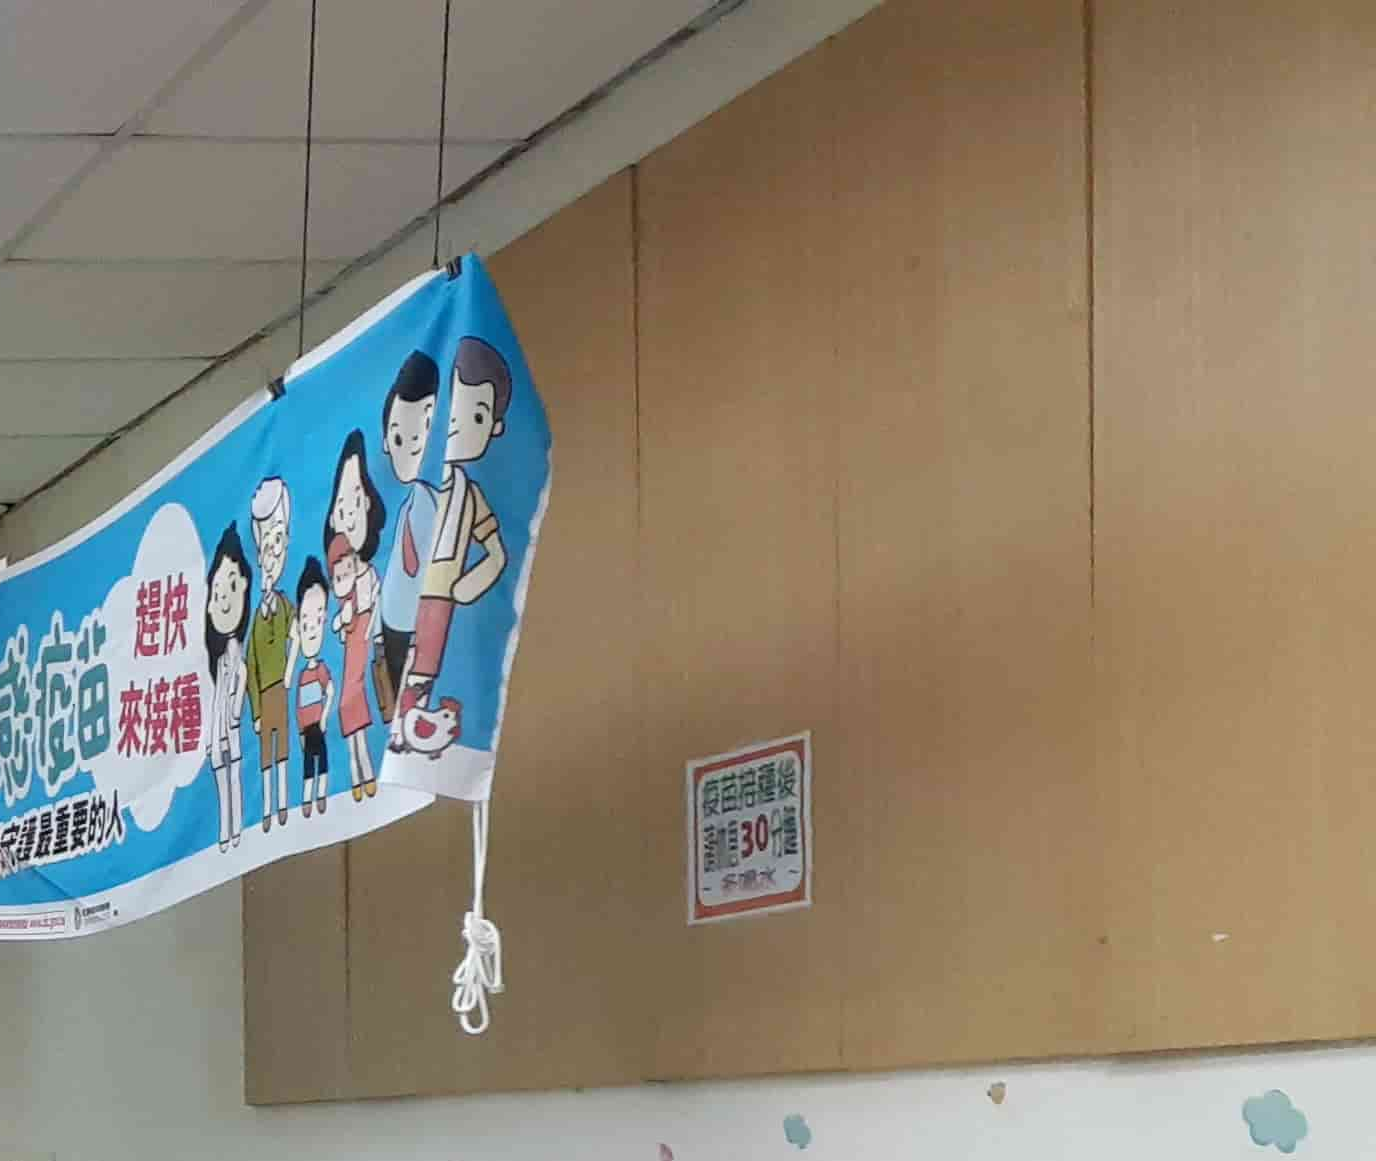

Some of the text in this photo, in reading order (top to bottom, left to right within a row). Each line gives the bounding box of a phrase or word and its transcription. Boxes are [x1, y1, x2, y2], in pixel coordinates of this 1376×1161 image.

[134, 572, 189, 658] 趕快
[117, 672, 202, 757] 來接種
